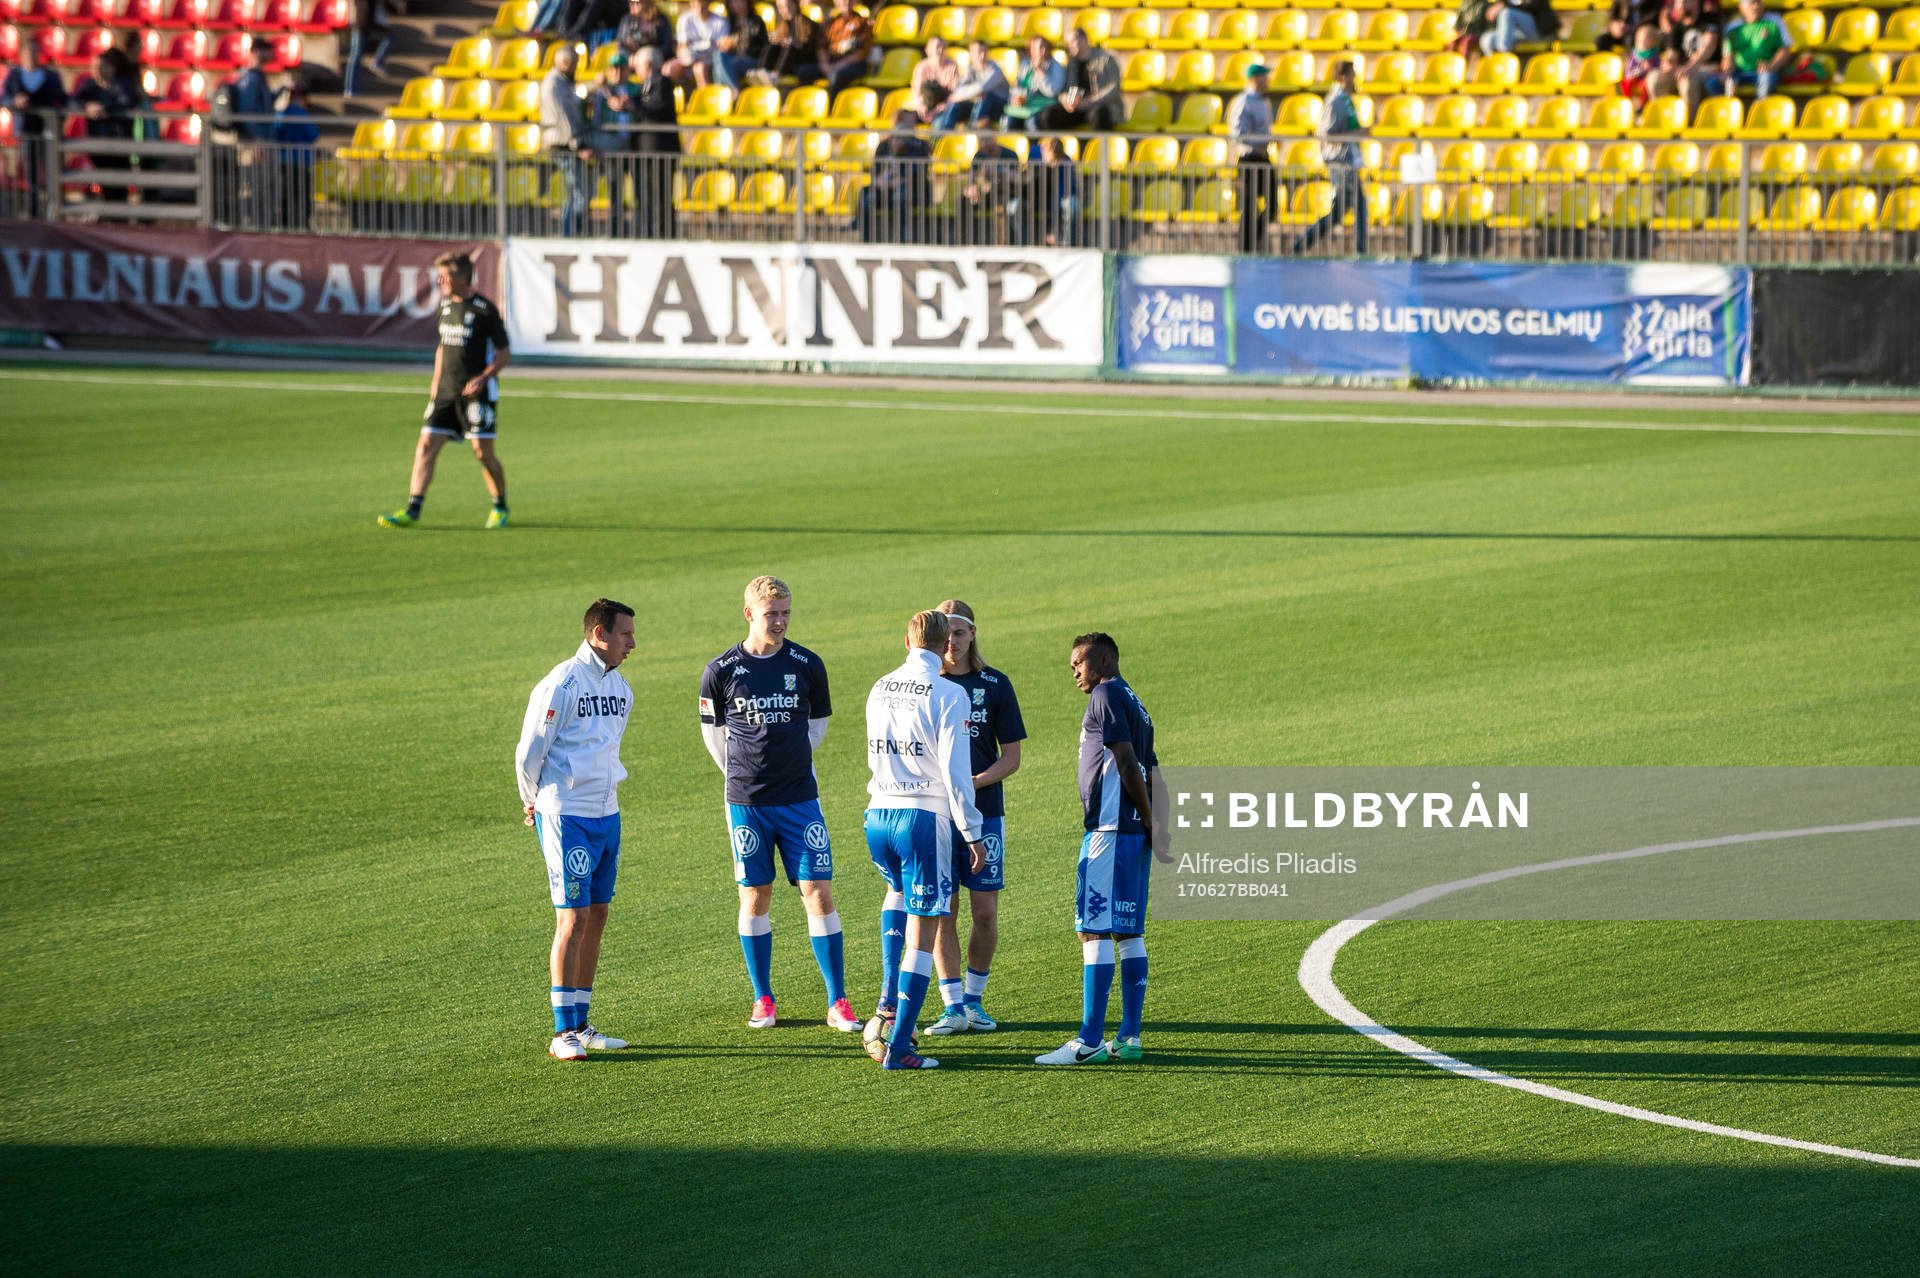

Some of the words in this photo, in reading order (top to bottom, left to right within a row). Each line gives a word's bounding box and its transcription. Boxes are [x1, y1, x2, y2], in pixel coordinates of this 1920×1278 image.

[2, 247, 304, 311] VILNIAUS
[316, 261, 478, 318] ALU
[544, 254, 1064, 350] HANNER
[1150, 289, 1215, 325] Žalia
[1253, 301, 1354, 331] GYVYBĖ
[1357, 301, 1380, 332] IŠ
[1382, 307, 1501, 336] LIETUVOS
[1505, 309, 1603, 342] GELMIŲ
[1645, 298, 1713, 335] Žalia
[1152, 321, 1215, 352] giria
[1647, 332, 1713, 362] giria
[734, 693, 799, 712] Prioritet
[746, 710, 791, 725] Finans
[816, 853, 830, 866] 20
[990, 865, 998, 878] 9
[912, 884, 934, 895] NRC
[1115, 901, 1136, 912] NRC
[1112, 914, 1136, 927] Group
